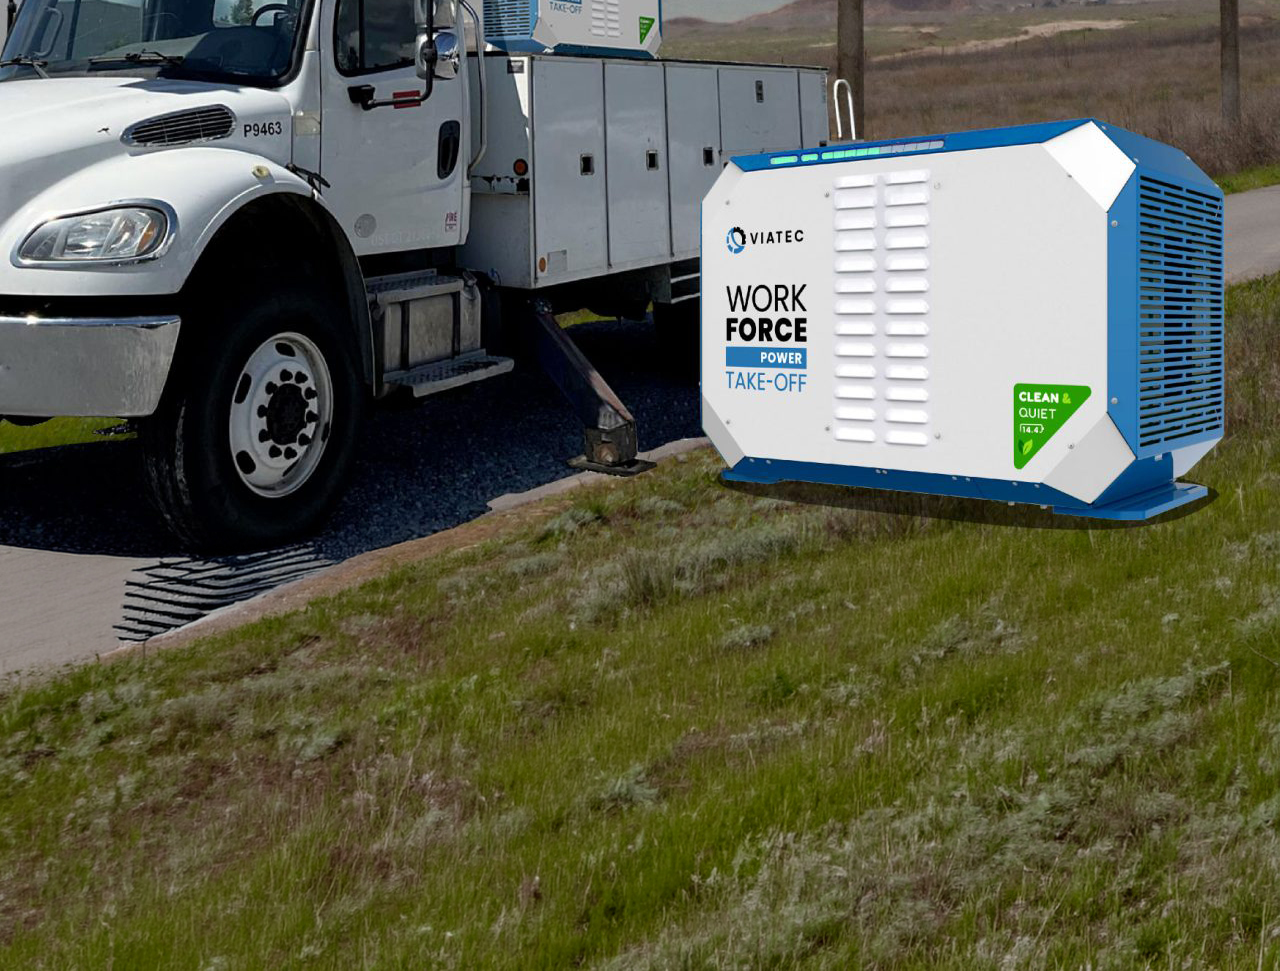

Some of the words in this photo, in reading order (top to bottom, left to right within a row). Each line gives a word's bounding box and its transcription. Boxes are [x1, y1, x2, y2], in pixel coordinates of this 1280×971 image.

[549, 1, 582, 14] TAKE-OFF
[243, 121, 283, 138] P9463
[750, 230, 804, 245] VIATEC
[726, 284, 807, 312] WORK
[726, 317, 807, 342] FORCE
[760, 352, 802, 365] POWER
[725, 371, 807, 392] TAKE-OFF
[1018, 391, 1059, 404] CLEAN
[1062, 392, 1072, 405] &
[1018, 407, 1057, 419] QUIET
